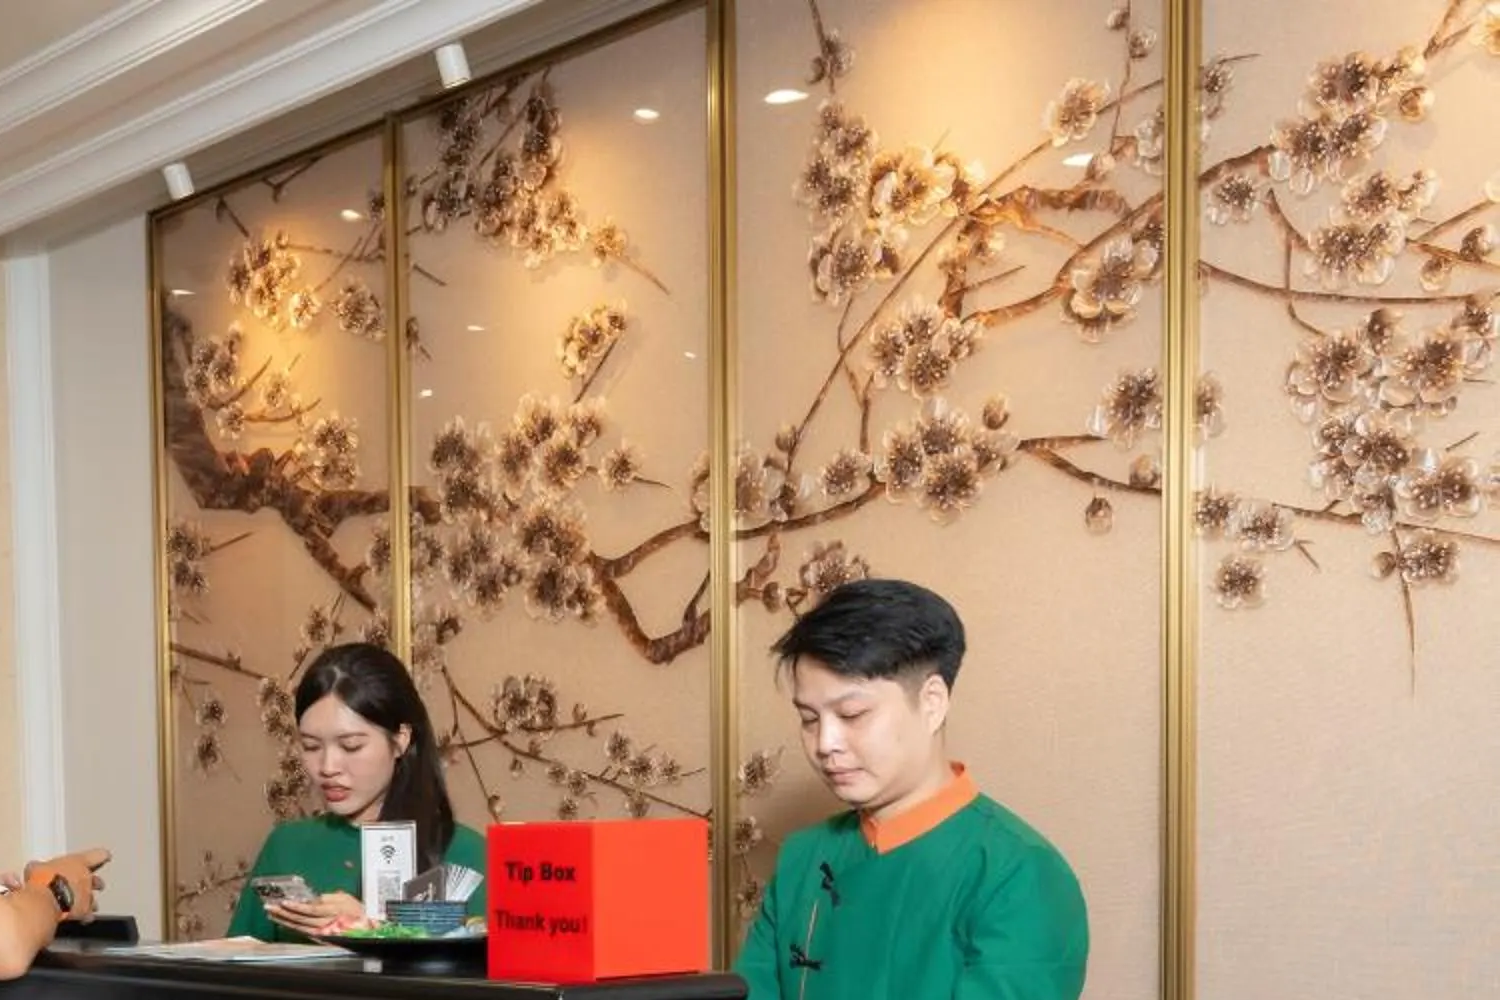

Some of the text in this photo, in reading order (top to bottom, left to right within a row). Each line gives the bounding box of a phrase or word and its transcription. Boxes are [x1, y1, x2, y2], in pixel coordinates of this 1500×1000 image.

[505, 862, 576, 886] Tip Box
[495, 910, 588, 938] Thank you!
